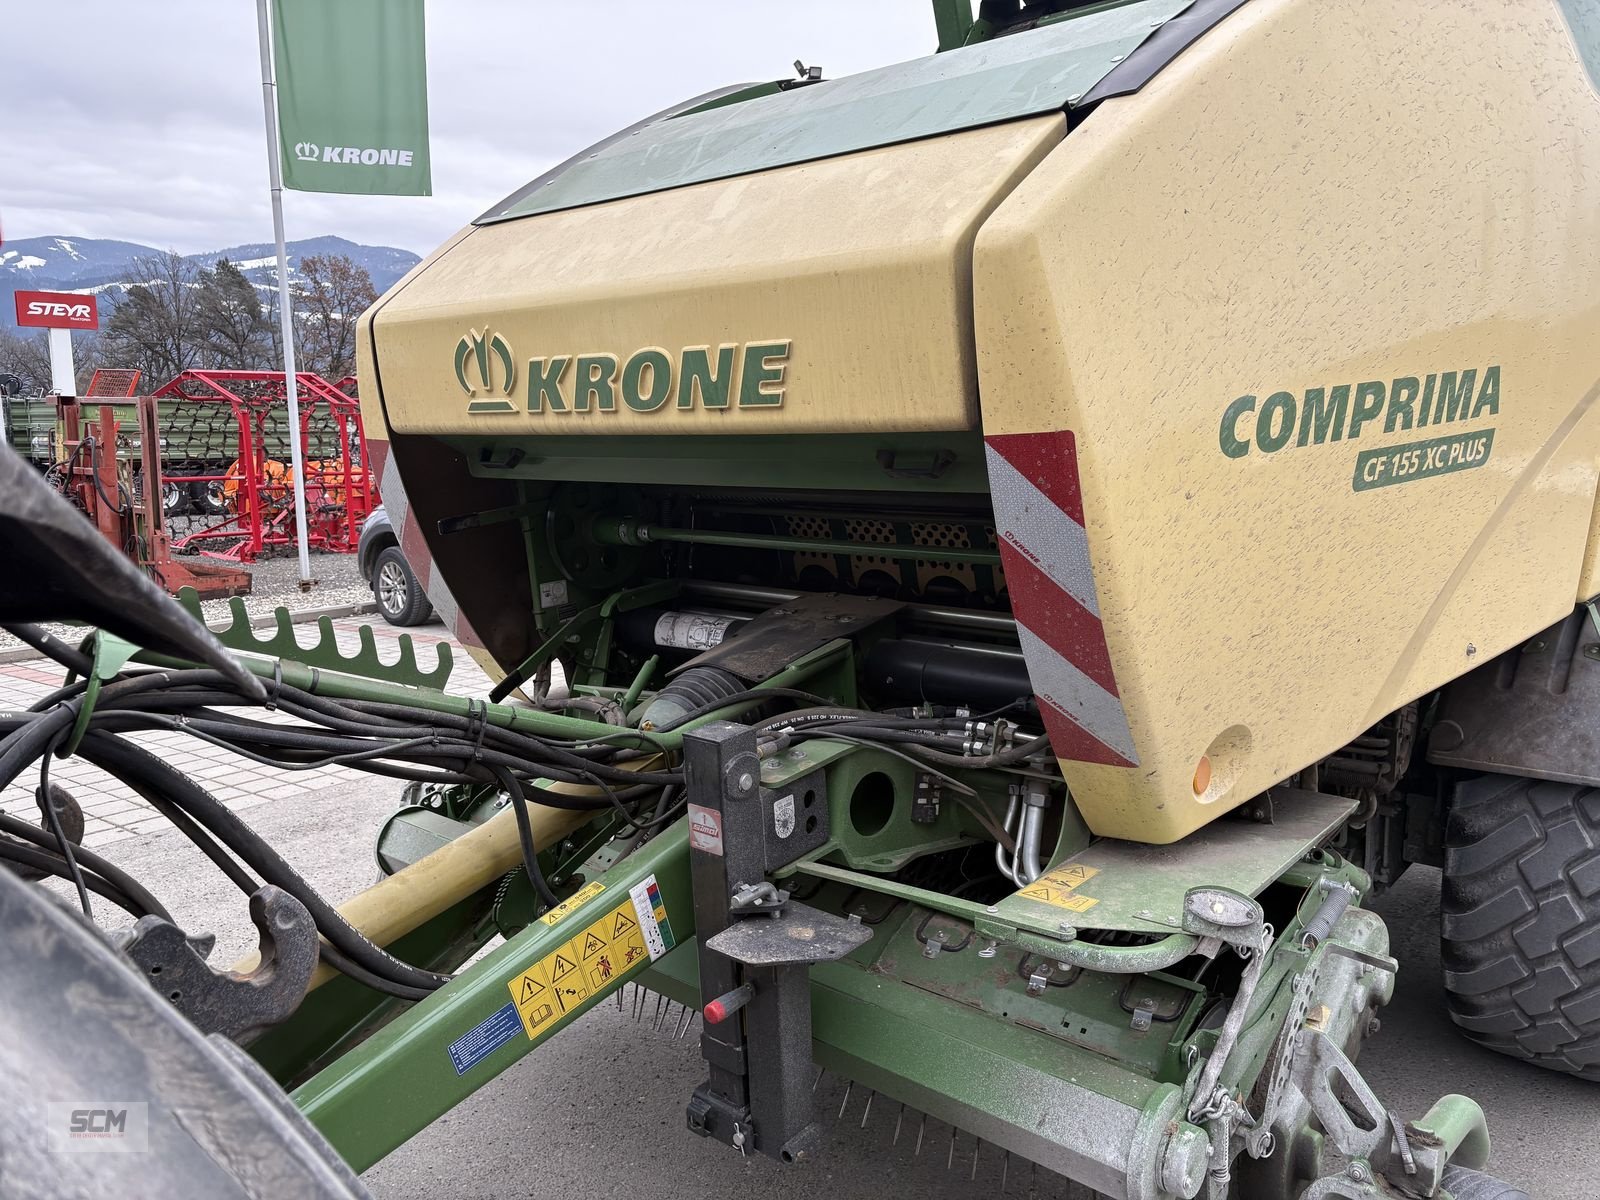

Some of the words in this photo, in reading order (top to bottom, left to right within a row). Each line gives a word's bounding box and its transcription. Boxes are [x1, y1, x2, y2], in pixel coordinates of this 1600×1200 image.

[322, 146, 414, 167] KRONE
[27, 301, 91, 318] STEYR
[527, 338, 792, 414] KRONE
[1218, 365, 1501, 459] COMPRIMA
[1363, 455, 1388, 483] CF
[1391, 449, 1422, 477] 155
[1422, 444, 1448, 471] XC
[1448, 437, 1487, 466] PLUS
[1012, 539, 1041, 564] KRONE
[1051, 701, 1080, 721] KRONE
